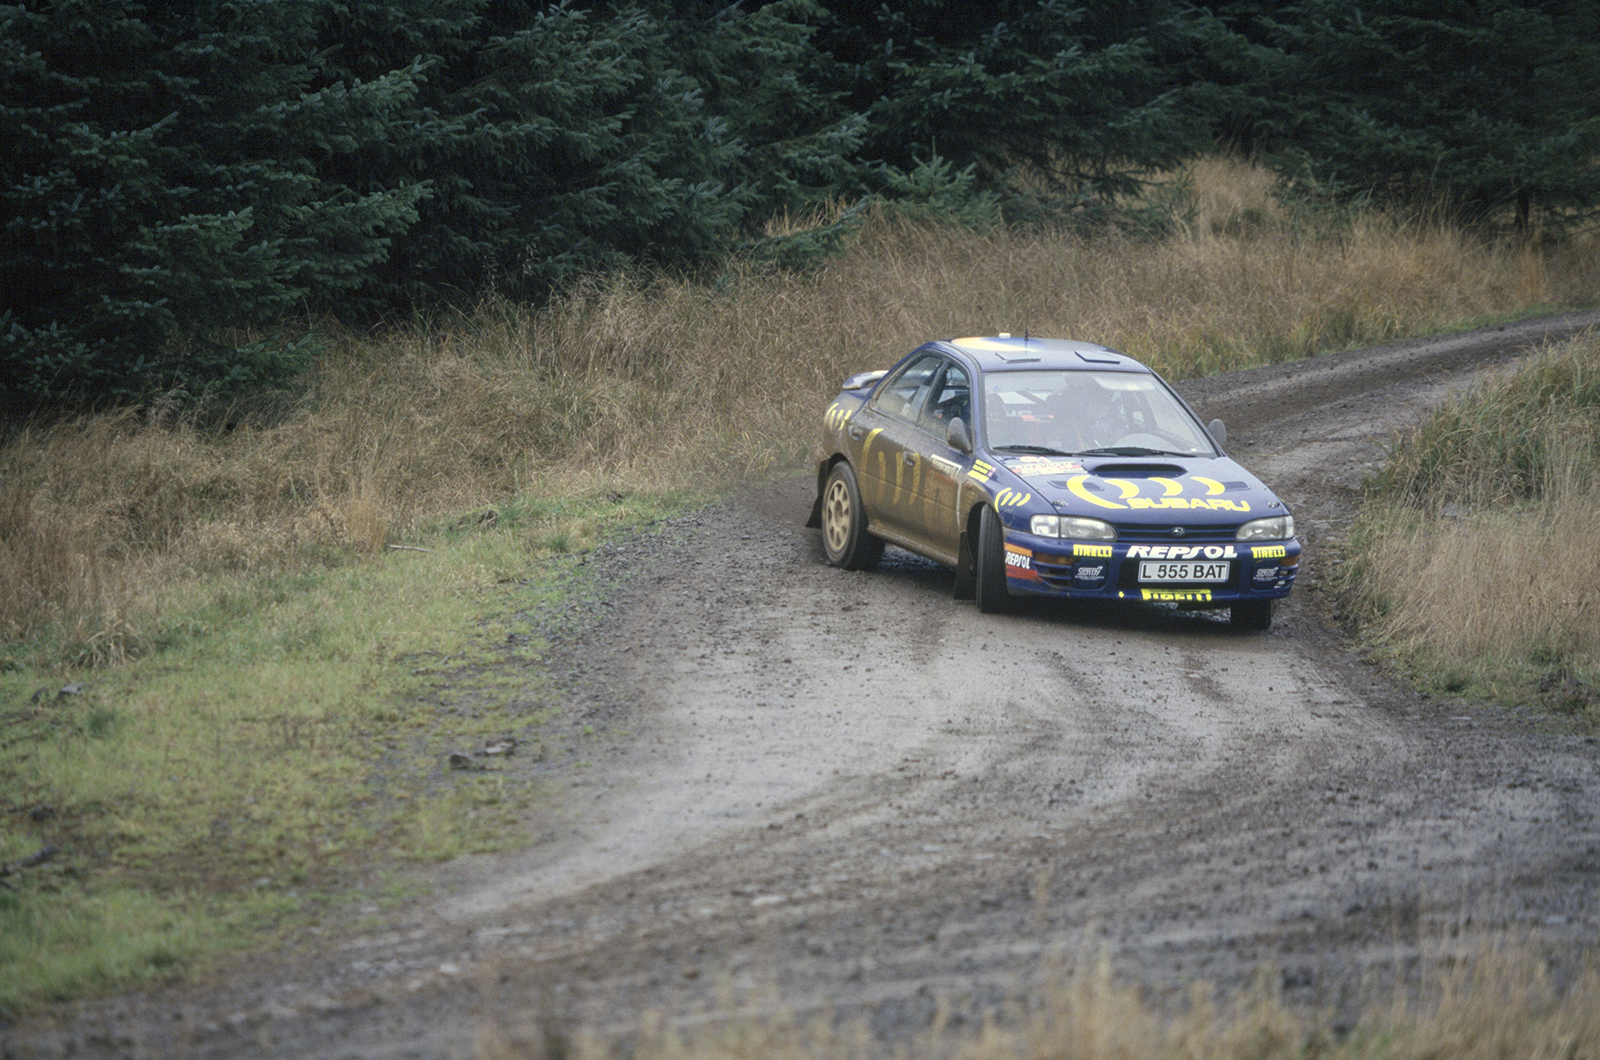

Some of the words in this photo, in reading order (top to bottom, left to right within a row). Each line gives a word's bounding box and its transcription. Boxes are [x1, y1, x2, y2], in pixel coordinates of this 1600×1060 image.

[1127, 498, 1250, 512] SUBARU
[1073, 544, 1113, 557] PIRELLI
[1126, 545, 1237, 559] REPSOL
[1251, 545, 1285, 558] PIRELLI
[1005, 551, 1030, 569] REPSOL
[1142, 565, 1152, 578] L
[1157, 565, 1188, 579] 555
[1193, 564, 1226, 579] BAT
